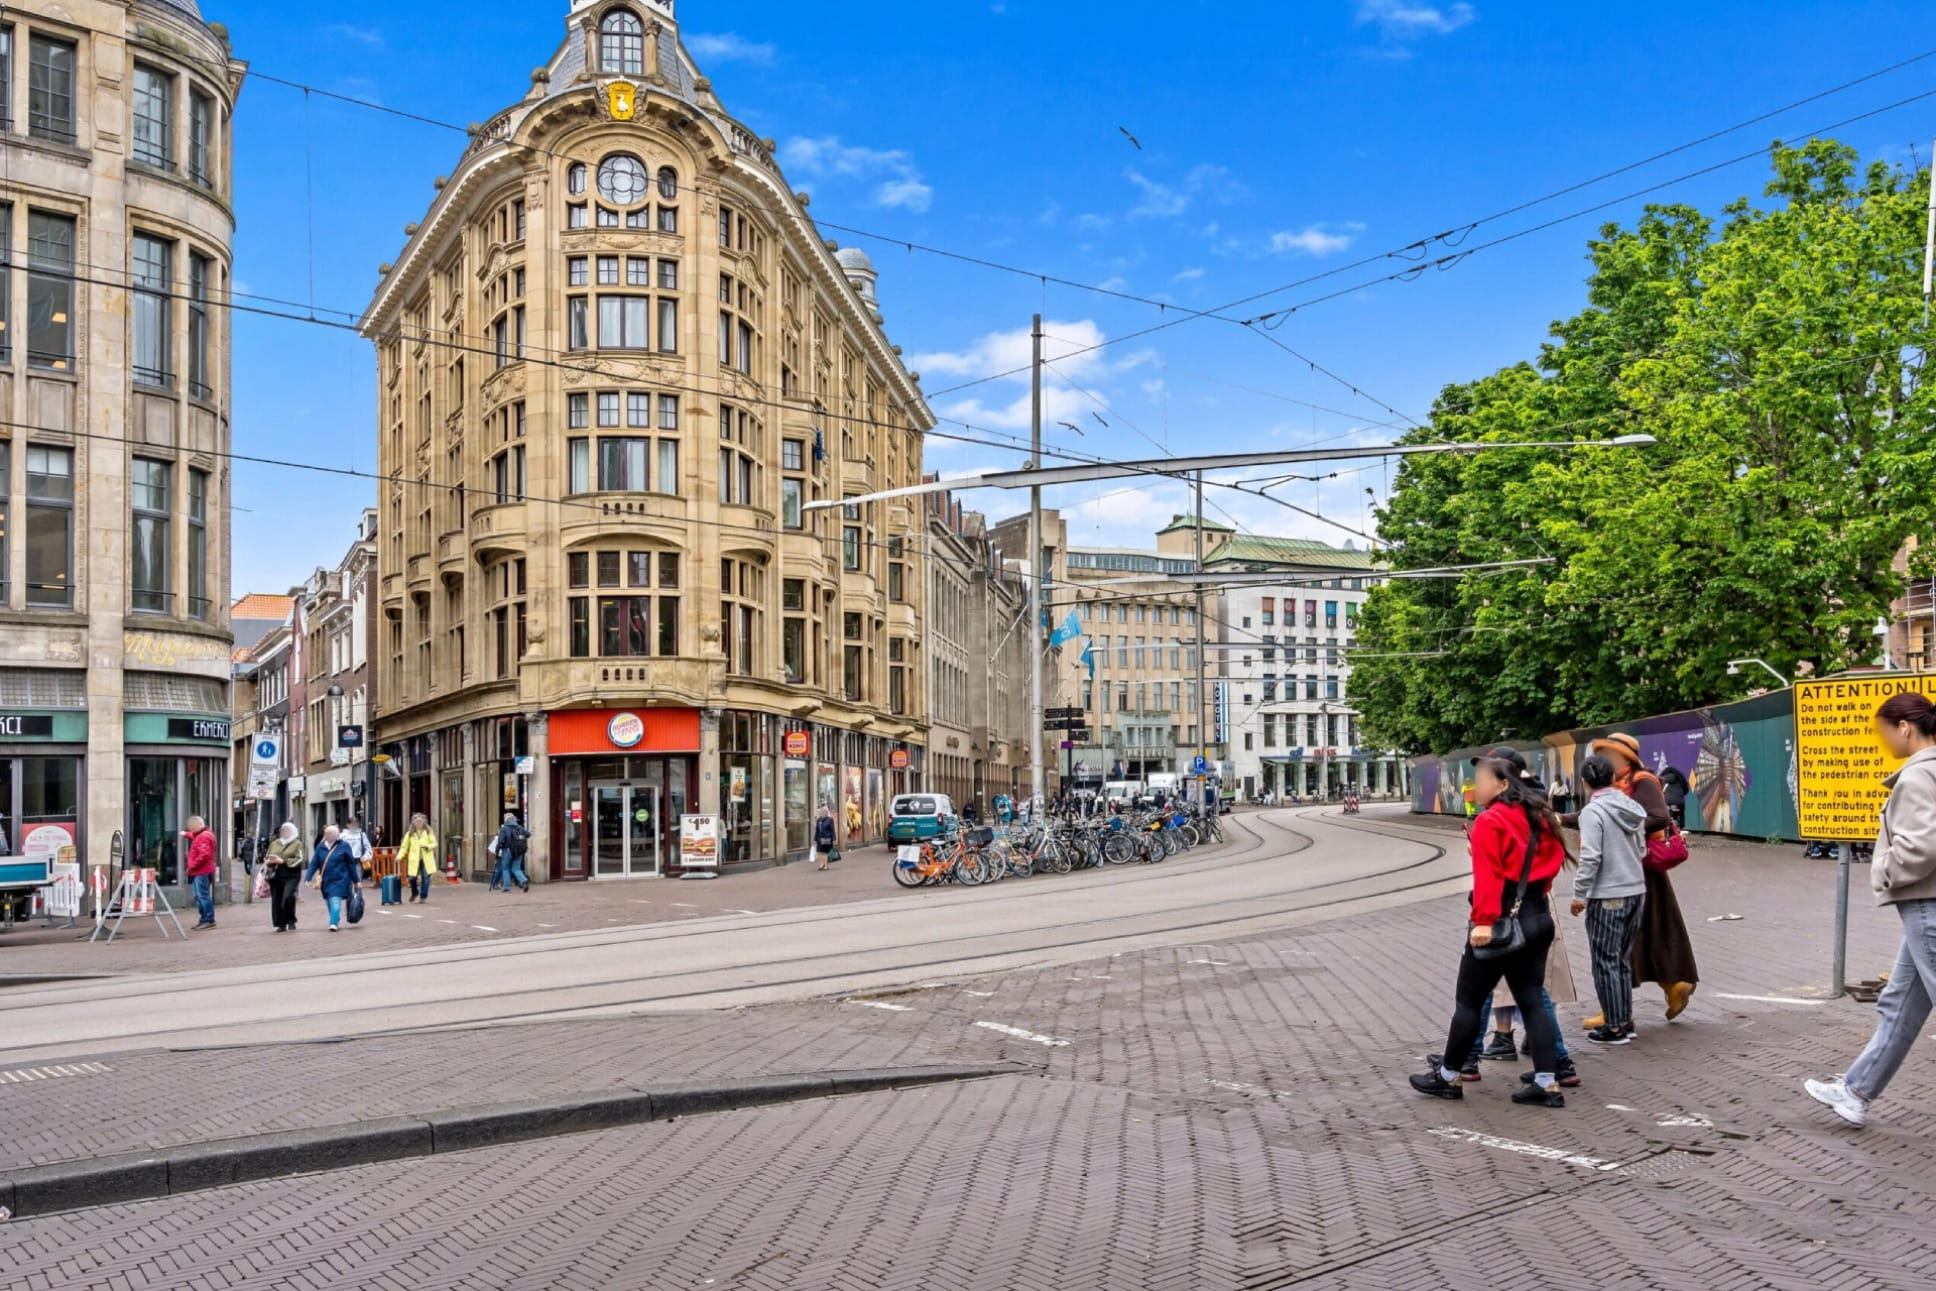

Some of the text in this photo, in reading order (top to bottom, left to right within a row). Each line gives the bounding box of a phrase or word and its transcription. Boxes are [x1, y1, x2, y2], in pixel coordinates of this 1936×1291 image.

[1801, 681, 1916, 699] ATTENTION!
[1802, 702, 1872, 713] Do not walk on
[1802, 715, 1870, 725] the side of the
[1802, 727, 1860, 737] construction
[1803, 745, 1827, 755] Cross
[1831, 745, 1845, 754] the
[1849, 745, 1878, 754] street
[1196, 757, 1203, 765] P
[1803, 757, 1884, 769] by making use of
[1803, 770, 1816, 779] the
[1820, 770, 1869, 780] pedestrian
[1803, 788, 1891, 800] Thank you in adva
[1803, 801, 1814, 810] for
[1817, 801, 1874, 812] contributing
[1804, 813, 1880, 824] safety around th
[1804, 826, 1880, 836] construction site
